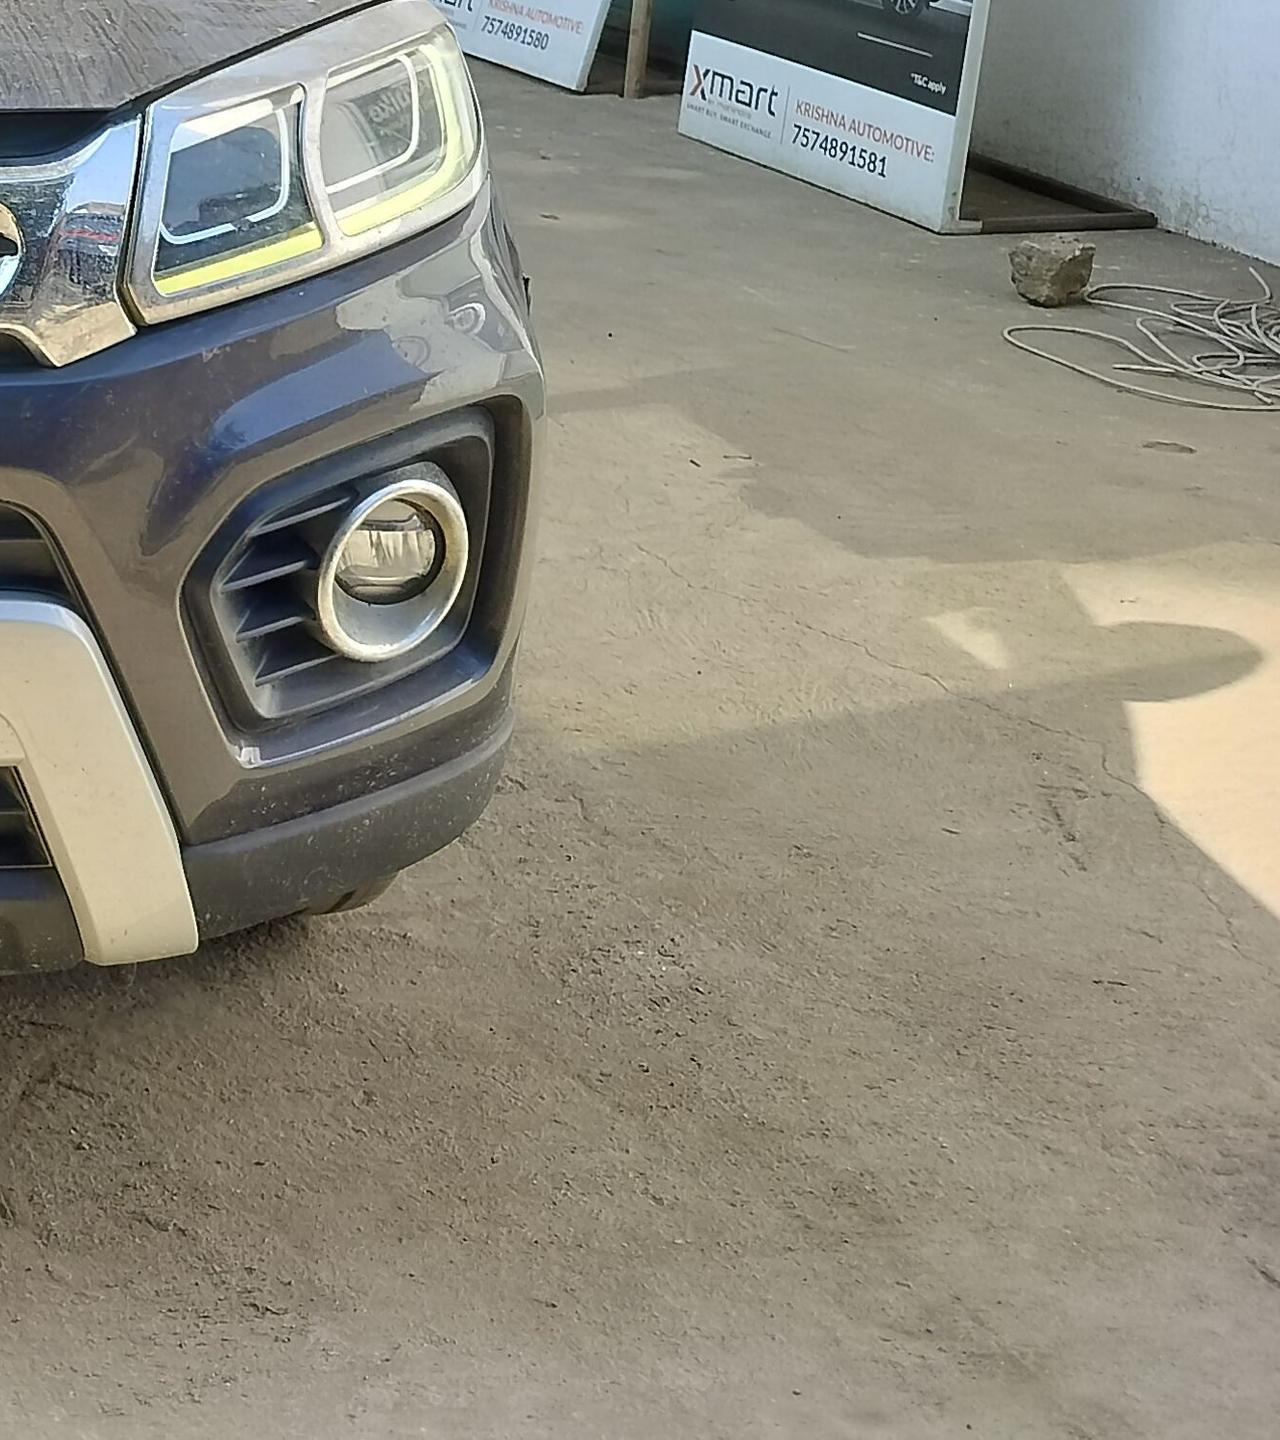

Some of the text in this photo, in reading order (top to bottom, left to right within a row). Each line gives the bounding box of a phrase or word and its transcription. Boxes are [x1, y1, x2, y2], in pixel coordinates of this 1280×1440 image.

[480, 15, 549, 50] 7574891580
[791, 123, 888, 179] 7574891581
[795, 99, 847, 131] KRISHNA
[848, 117, 935, 163] AUTOMOTIVE:
